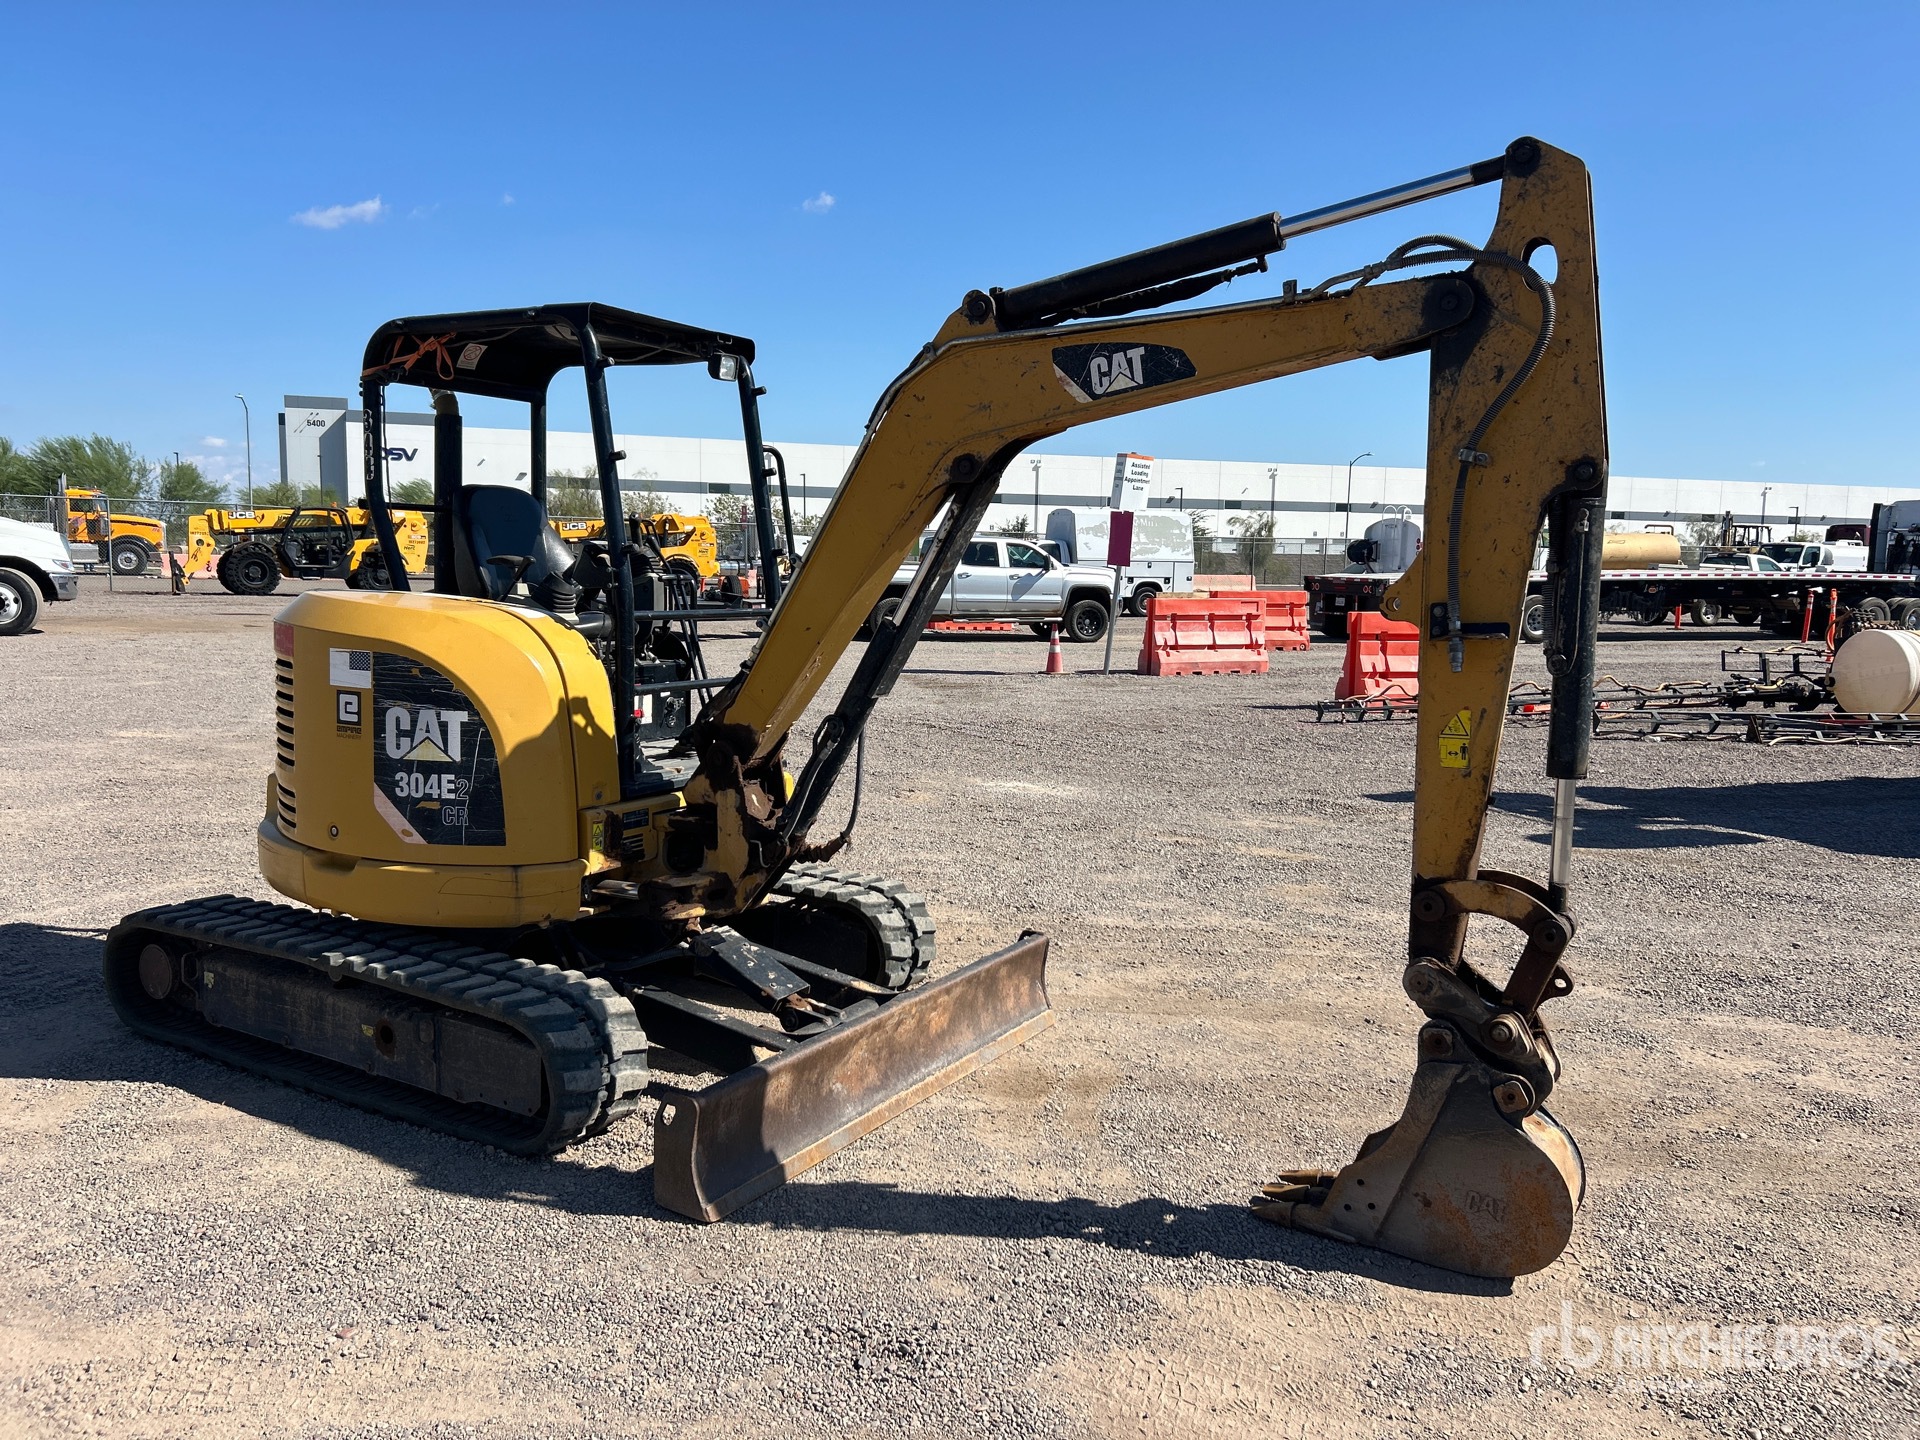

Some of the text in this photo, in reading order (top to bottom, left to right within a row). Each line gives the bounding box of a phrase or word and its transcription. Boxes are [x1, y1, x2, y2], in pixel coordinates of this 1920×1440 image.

[1090, 346, 1145, 395] CAT
[1131, 469, 1149, 478] Loading
[228, 511, 256, 519] JCB
[562, 522, 587, 531] JCB
[385, 706, 469, 763] CAT
[394, 771, 469, 800] 304E2
[441, 805, 469, 826] CR
